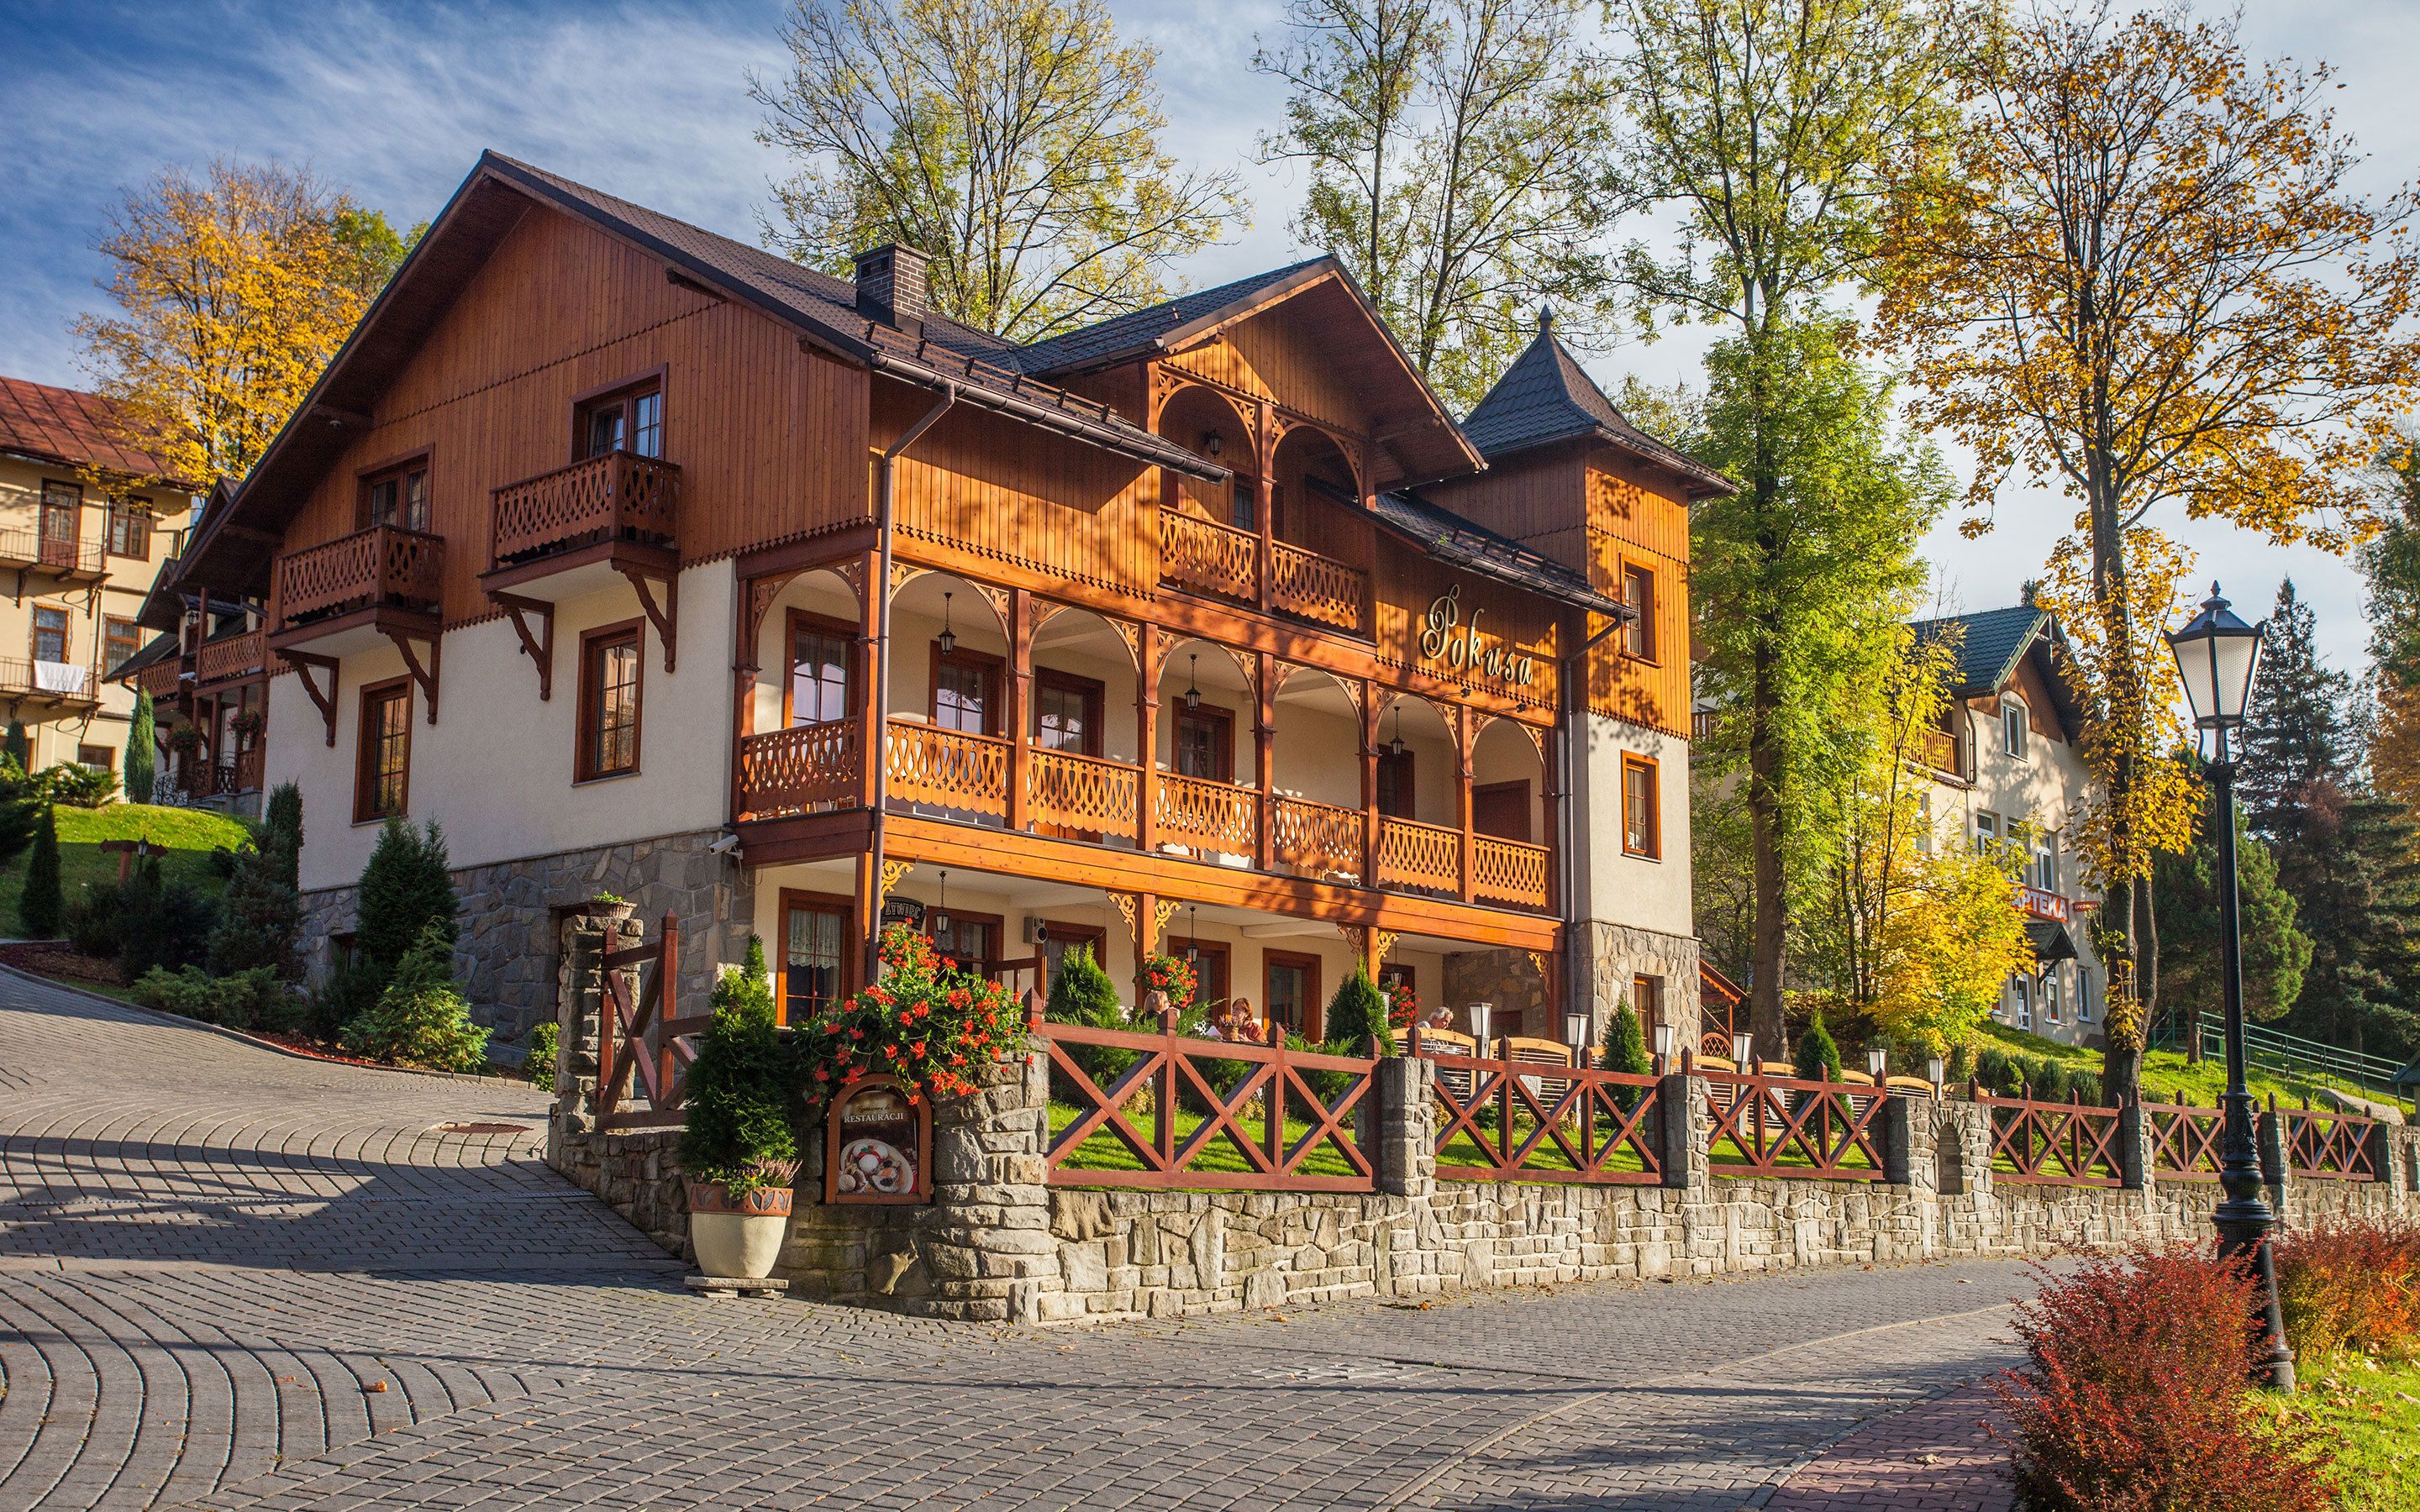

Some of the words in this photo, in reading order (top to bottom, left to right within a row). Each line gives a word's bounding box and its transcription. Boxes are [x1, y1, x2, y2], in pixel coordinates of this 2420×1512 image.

[1422, 584, 1534, 685] Pokusa
[2011, 887, 2068, 921] APTEKA
[844, 1112, 904, 1123] RESTAURACJI
